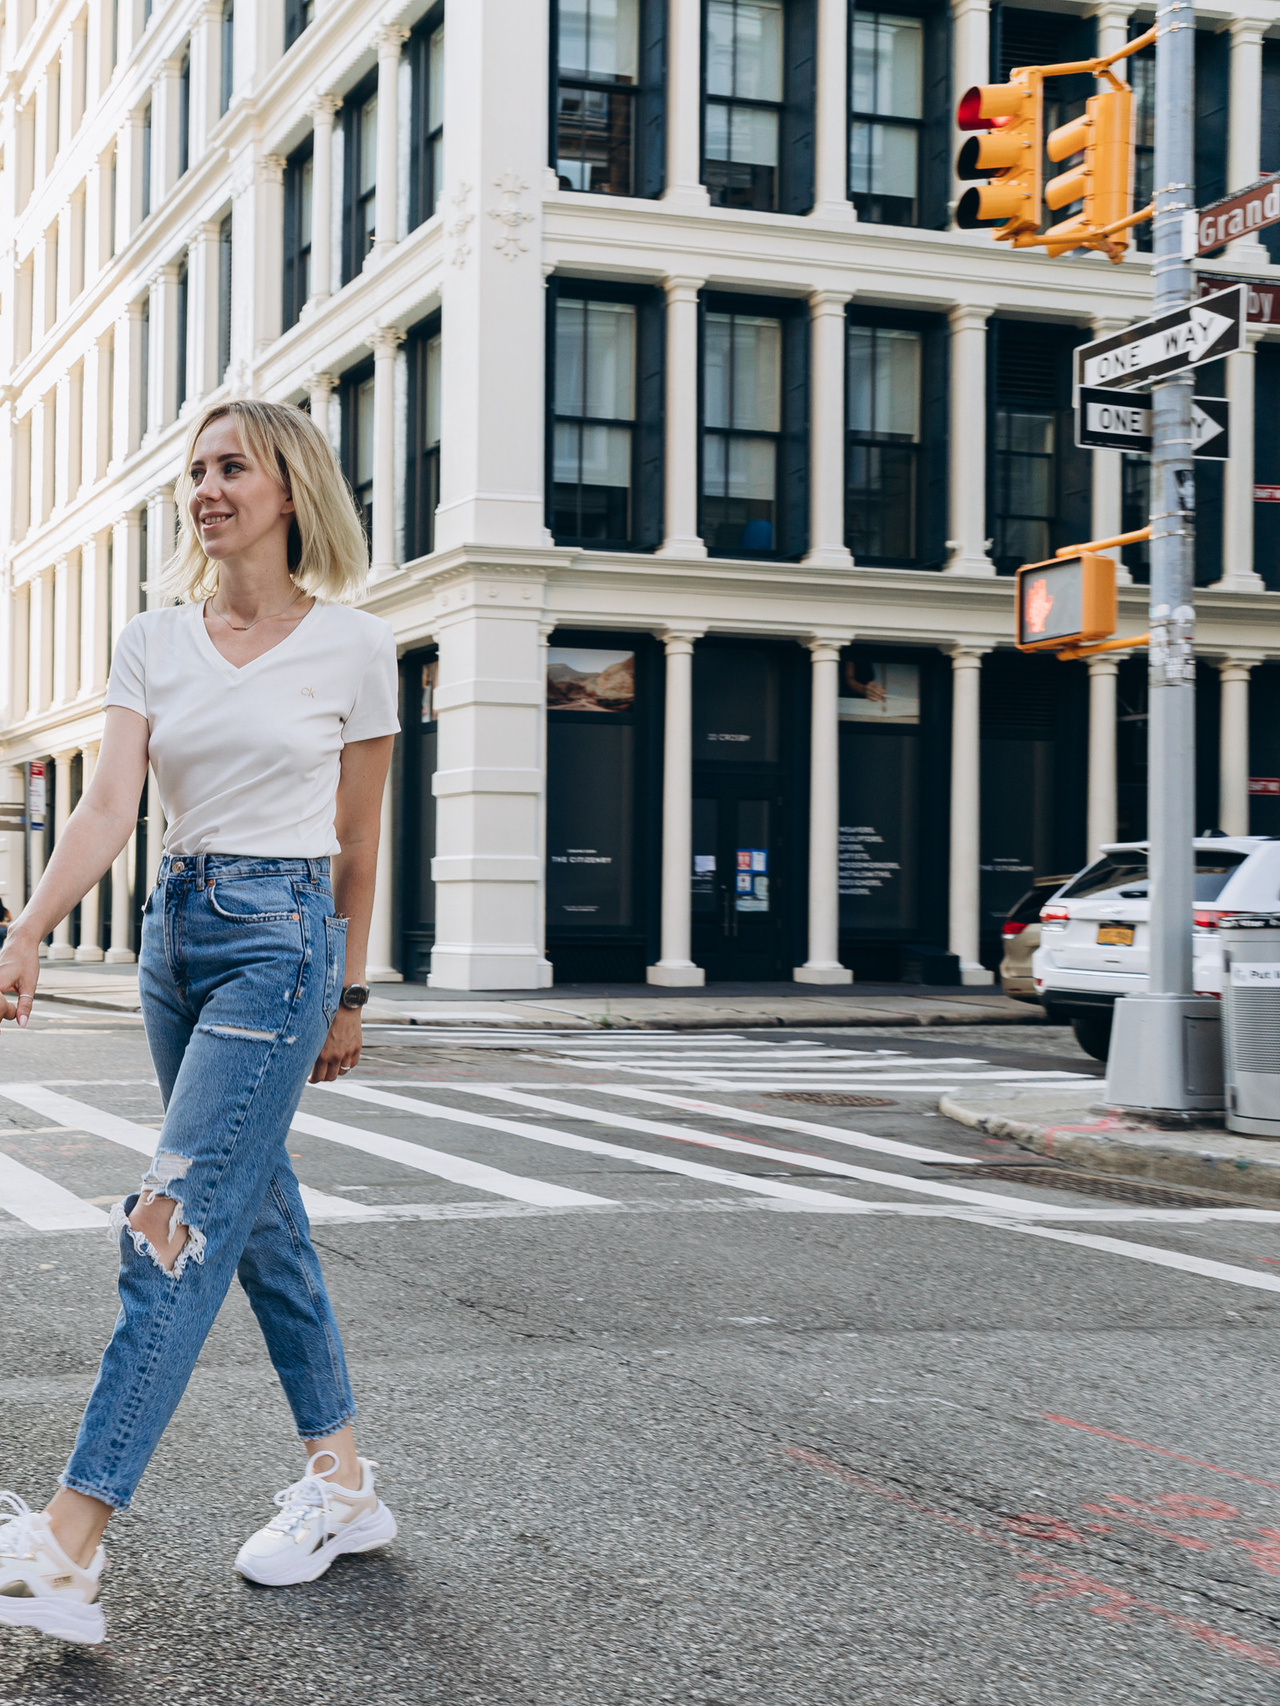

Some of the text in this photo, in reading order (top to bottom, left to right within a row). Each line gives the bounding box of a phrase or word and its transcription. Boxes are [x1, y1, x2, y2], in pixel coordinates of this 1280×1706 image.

[1199, 183, 1280, 247] Grand
[1097, 317, 1216, 379] ONE WAY
[1098, 408, 1143, 433] ONE
